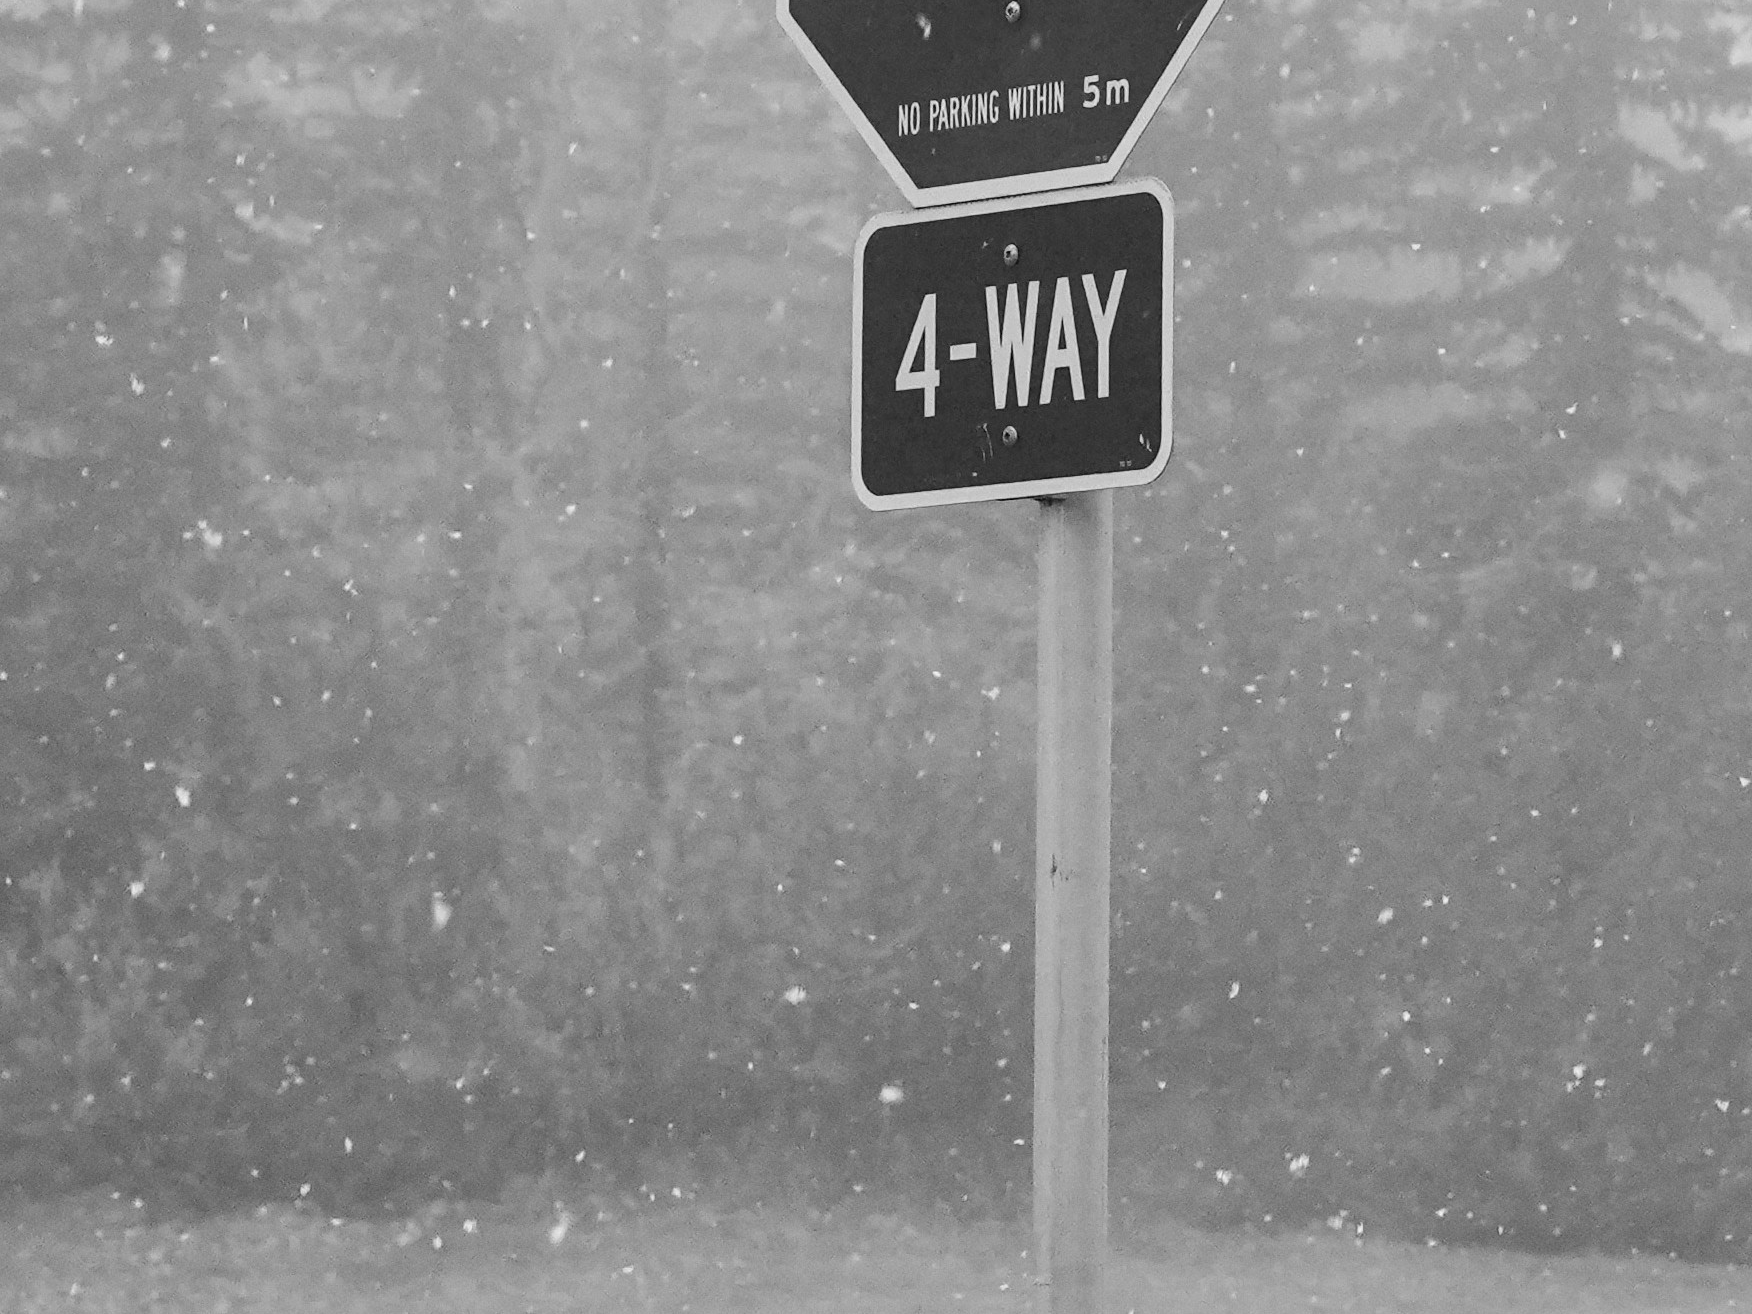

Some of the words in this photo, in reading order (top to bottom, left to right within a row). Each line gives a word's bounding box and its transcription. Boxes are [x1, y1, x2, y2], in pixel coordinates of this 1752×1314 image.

[898, 102, 921, 136] NO
[929, 89, 999, 132] PARKING
[1008, 80, 1064, 121] WITHIN
[895, 269, 1128, 417] 4-WAY
